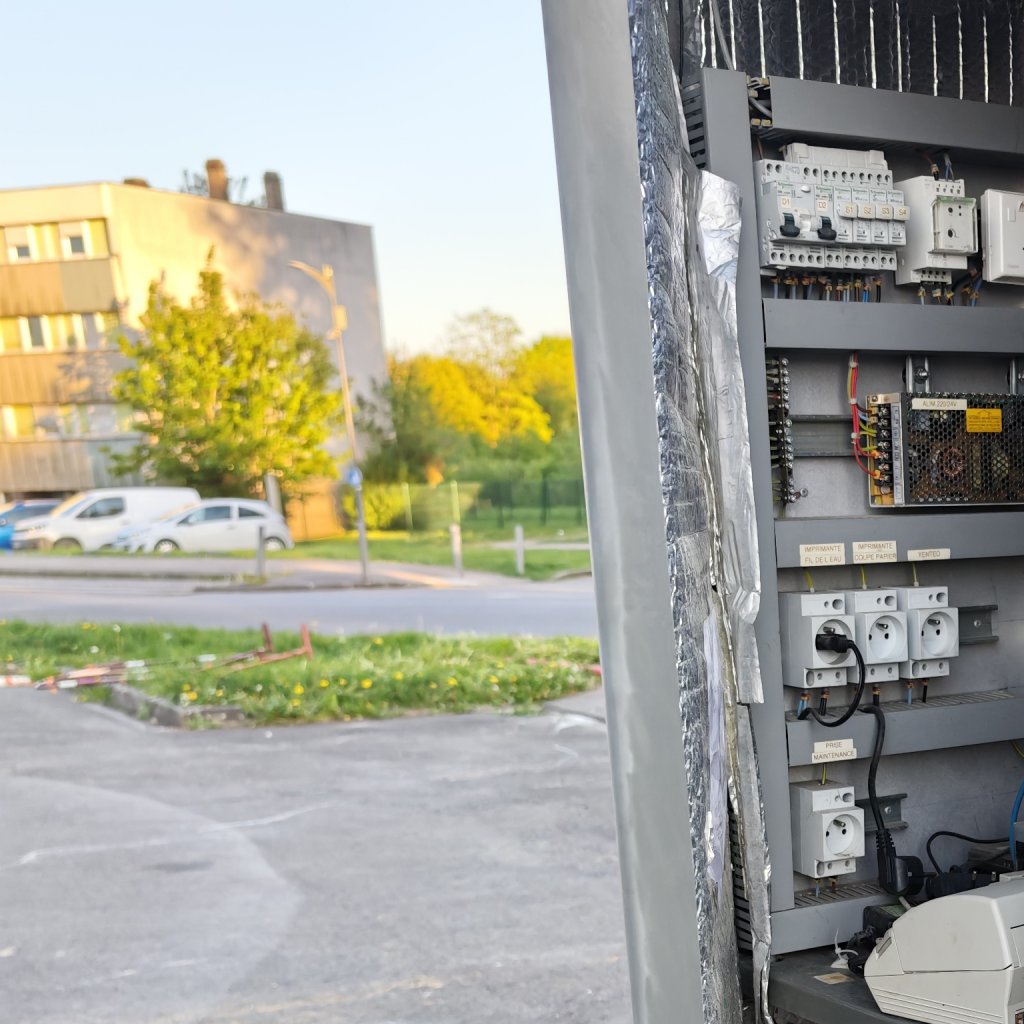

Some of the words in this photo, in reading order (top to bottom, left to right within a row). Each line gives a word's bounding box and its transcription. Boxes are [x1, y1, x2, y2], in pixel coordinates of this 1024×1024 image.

[863, 206, 873, 215] S2
[881, 207, 891, 215] S3
[804, 545, 842, 553] IMPRIMANTE
[858, 542, 894, 550] IMPRIMANTE
[813, 750, 855, 760] MAINTENANCE
